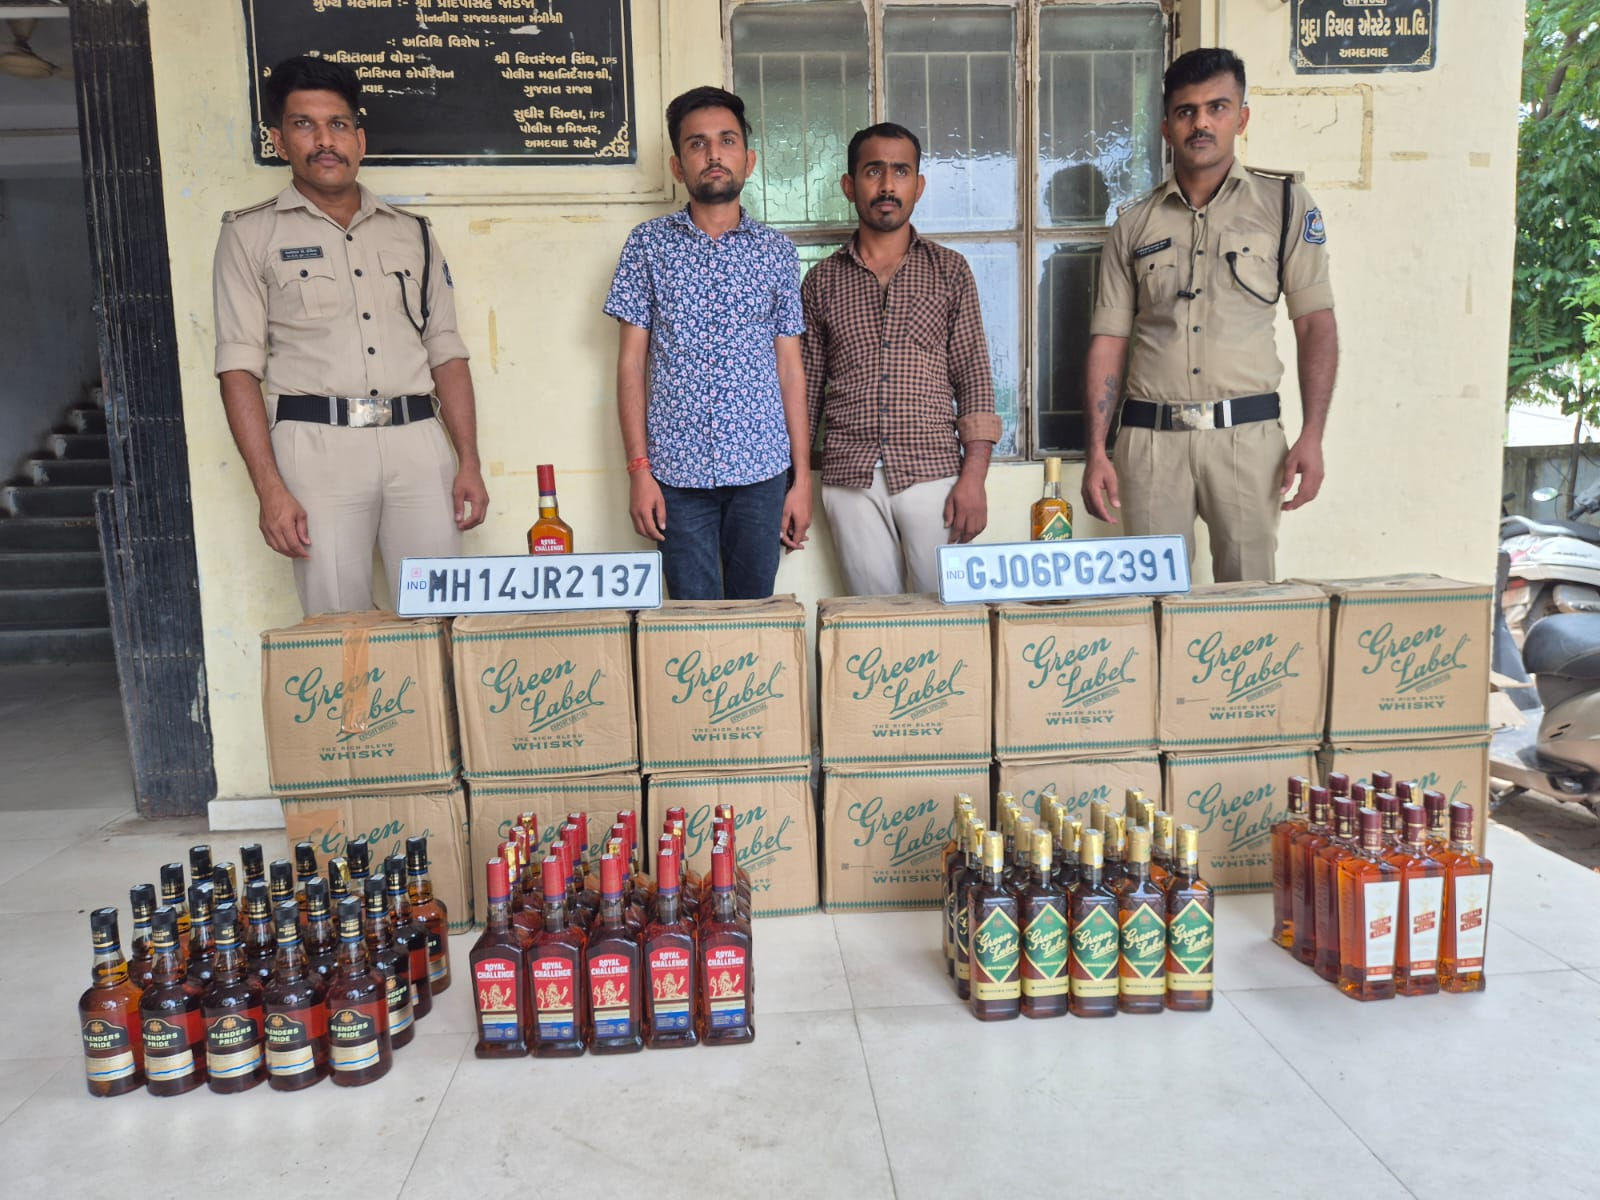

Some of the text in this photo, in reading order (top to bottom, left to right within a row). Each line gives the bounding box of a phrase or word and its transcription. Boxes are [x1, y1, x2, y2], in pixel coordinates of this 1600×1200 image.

[347, 0, 392, 8] મહમાન
[1325, 10, 1354, 37] રિયલ
[401, 34, 443, 47] અતિથિ
[448, 34, 480, 47] વિશેષ
[494, 51, 510, 65] શ્રી
[1338, 48, 1389, 58] અમદાવાદ
[501, 67, 535, 80] પોલીસ
[523, 85, 592, 98] ગુજરાત રાજ્ય
[513, 106, 544, 123] સુધીર
[589, 111, 605, 119] IPS
[519, 122, 552, 134] પોલીસ
[573, 136, 597, 149] શહેર
[946, 548, 1177, 590] IND GJ06PG2391
[407, 563, 652, 602] IND MH14JR2137
[1358, 622, 1447, 675] Green
[1022, 635, 1112, 689] Green
[1187, 631, 1279, 684] Green
[1391, 633, 1467, 688] Label
[846, 647, 940, 700] Green
[1057, 646, 1136, 702] Label
[1221, 642, 1299, 697] Label
[665, 650, 759, 704] Green
[481, 658, 576, 714] Green
[702, 661, 784, 718] Label
[883, 659, 965, 714] Label
[520, 669, 605, 727] Label
[1378, 701, 1446, 711] WHISKY
[1046, 715, 1114, 726] WHISKY
[1209, 709, 1277, 720] WHISKY
[692, 731, 763, 742] WHISKY
[872, 727, 943, 737] WHISKY
[512, 739, 585, 751] WHISKY
[320, 749, 396, 761] WHISKY
[1187, 782, 1277, 833] Green
[847, 796, 940, 848] Green
[873, 875, 942, 884] WHISKY
[659, 951, 680, 960] ROYAL
[715, 950, 736, 959] ROYAL
[484, 963, 506, 971] ROYAL
[541, 961, 563, 969] ROYAL
[598, 958, 620, 968] ROYAL
[651, 959, 689, 968] CHALLENGE
[707, 957, 745, 967] CHALLENGE
[477, 970, 515, 979] CHALLENGE
[534, 968, 571, 978] CHALLENGE
[590, 965, 628, 975] CHALLENGE
[210, 1025, 252, 1039] BLENDERS
[330, 1021, 369, 1032] BLENDERS
[219, 1035, 244, 1045] PRIDE
[337, 1030, 361, 1038] PRIDE
[147, 1040, 169, 1048] PRIDE
